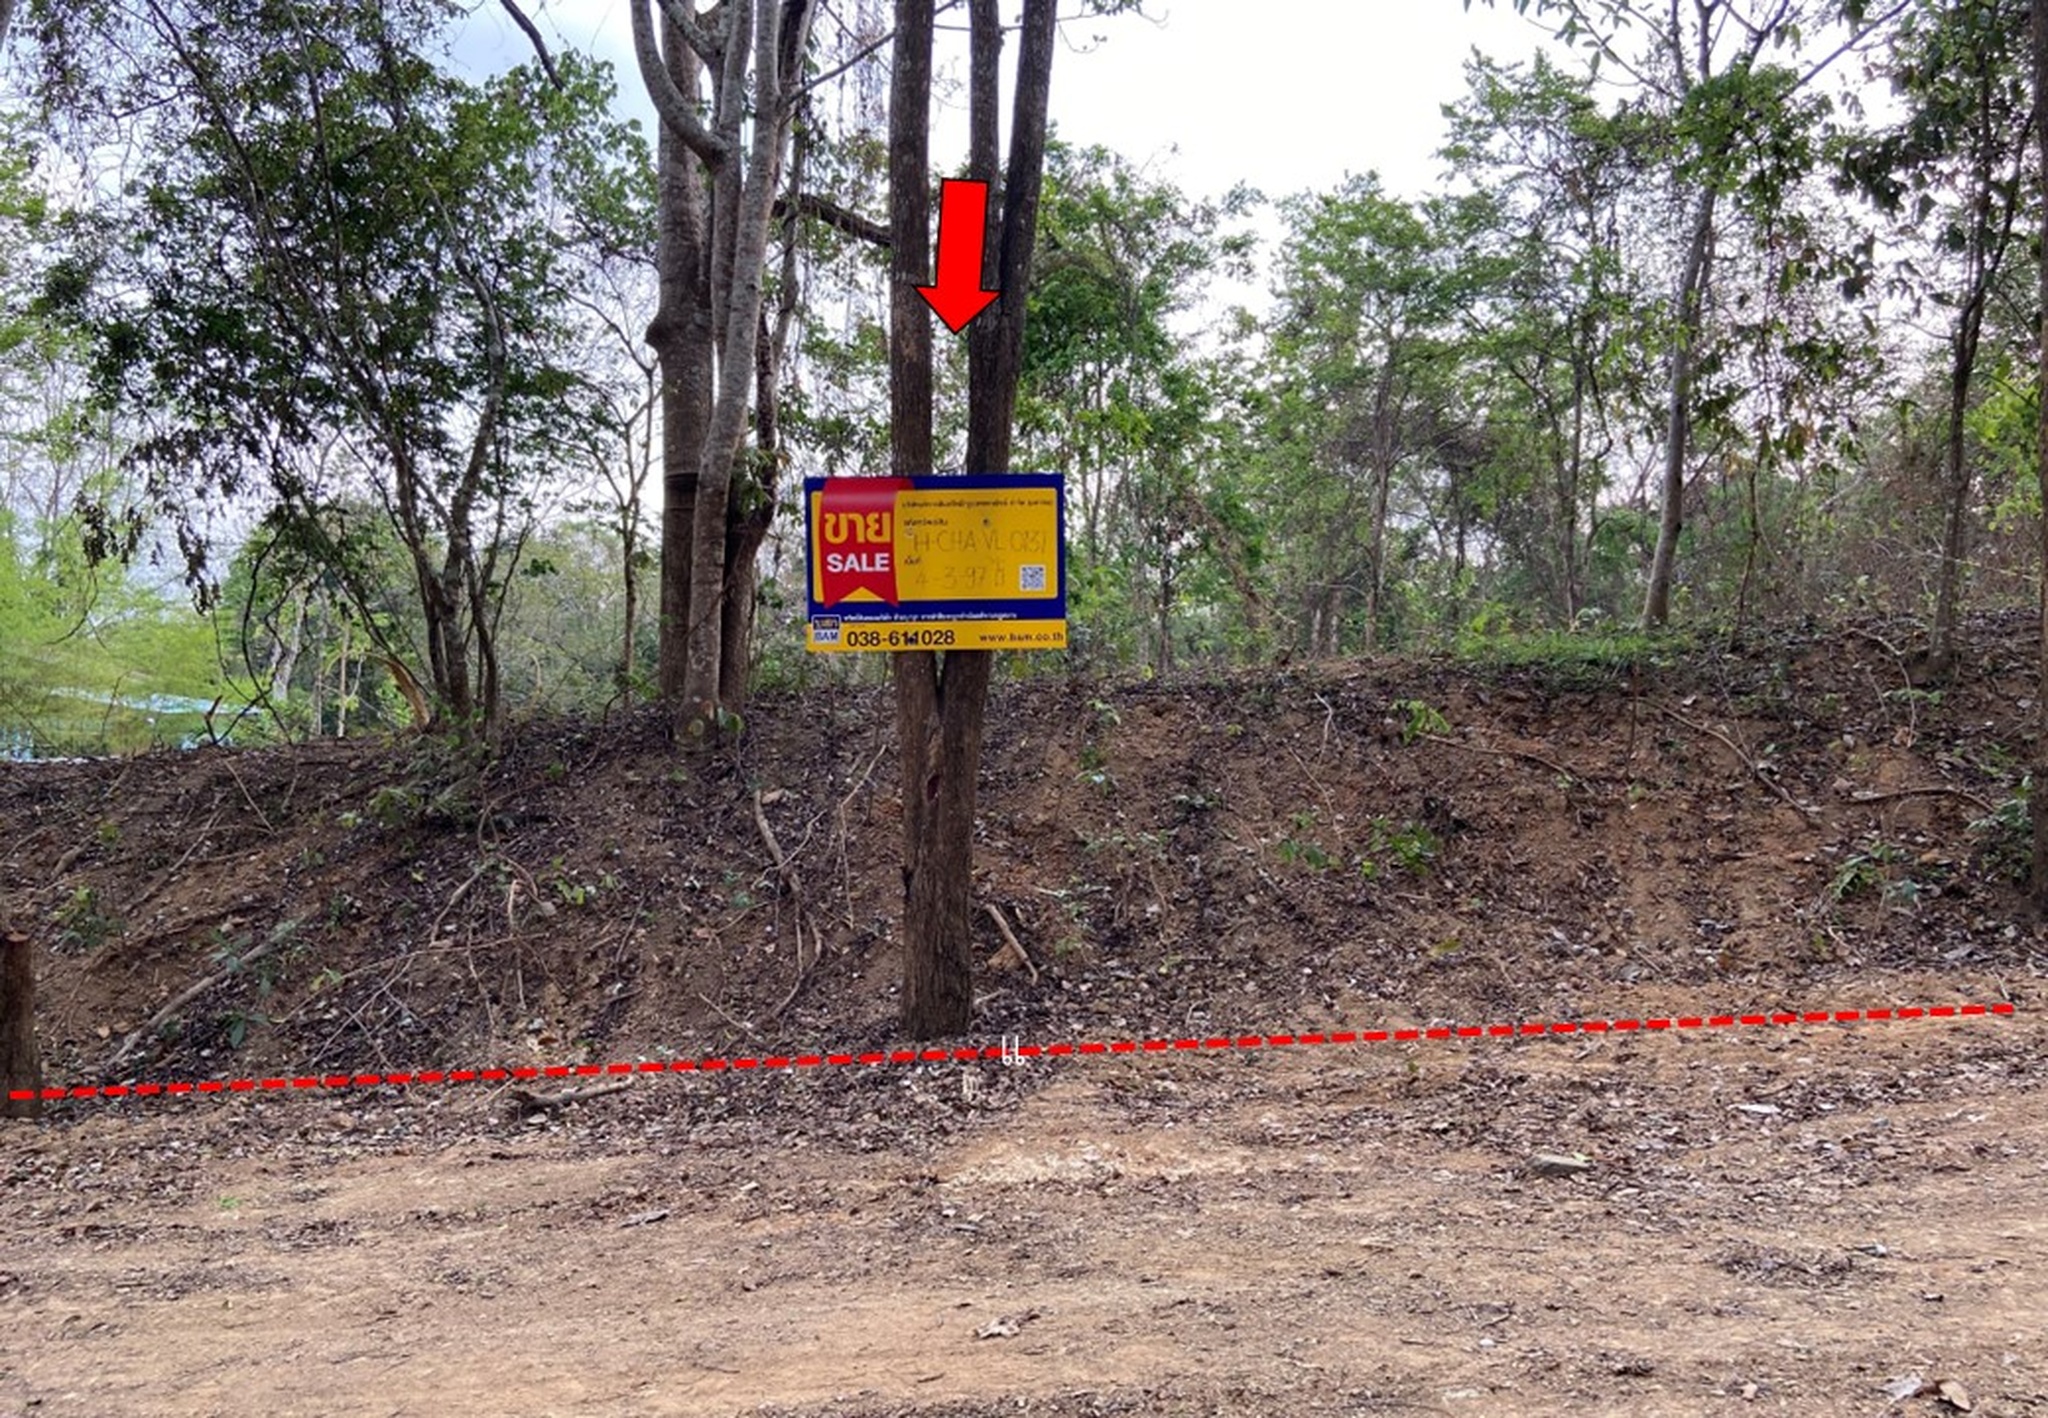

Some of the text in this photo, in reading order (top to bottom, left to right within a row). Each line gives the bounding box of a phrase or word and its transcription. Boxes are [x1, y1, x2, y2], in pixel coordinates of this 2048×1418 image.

[824, 512, 891, 544] ขาย
[826, 552, 890, 573] SALE
[979, 631, 1064, 642] www.bam.co.th
